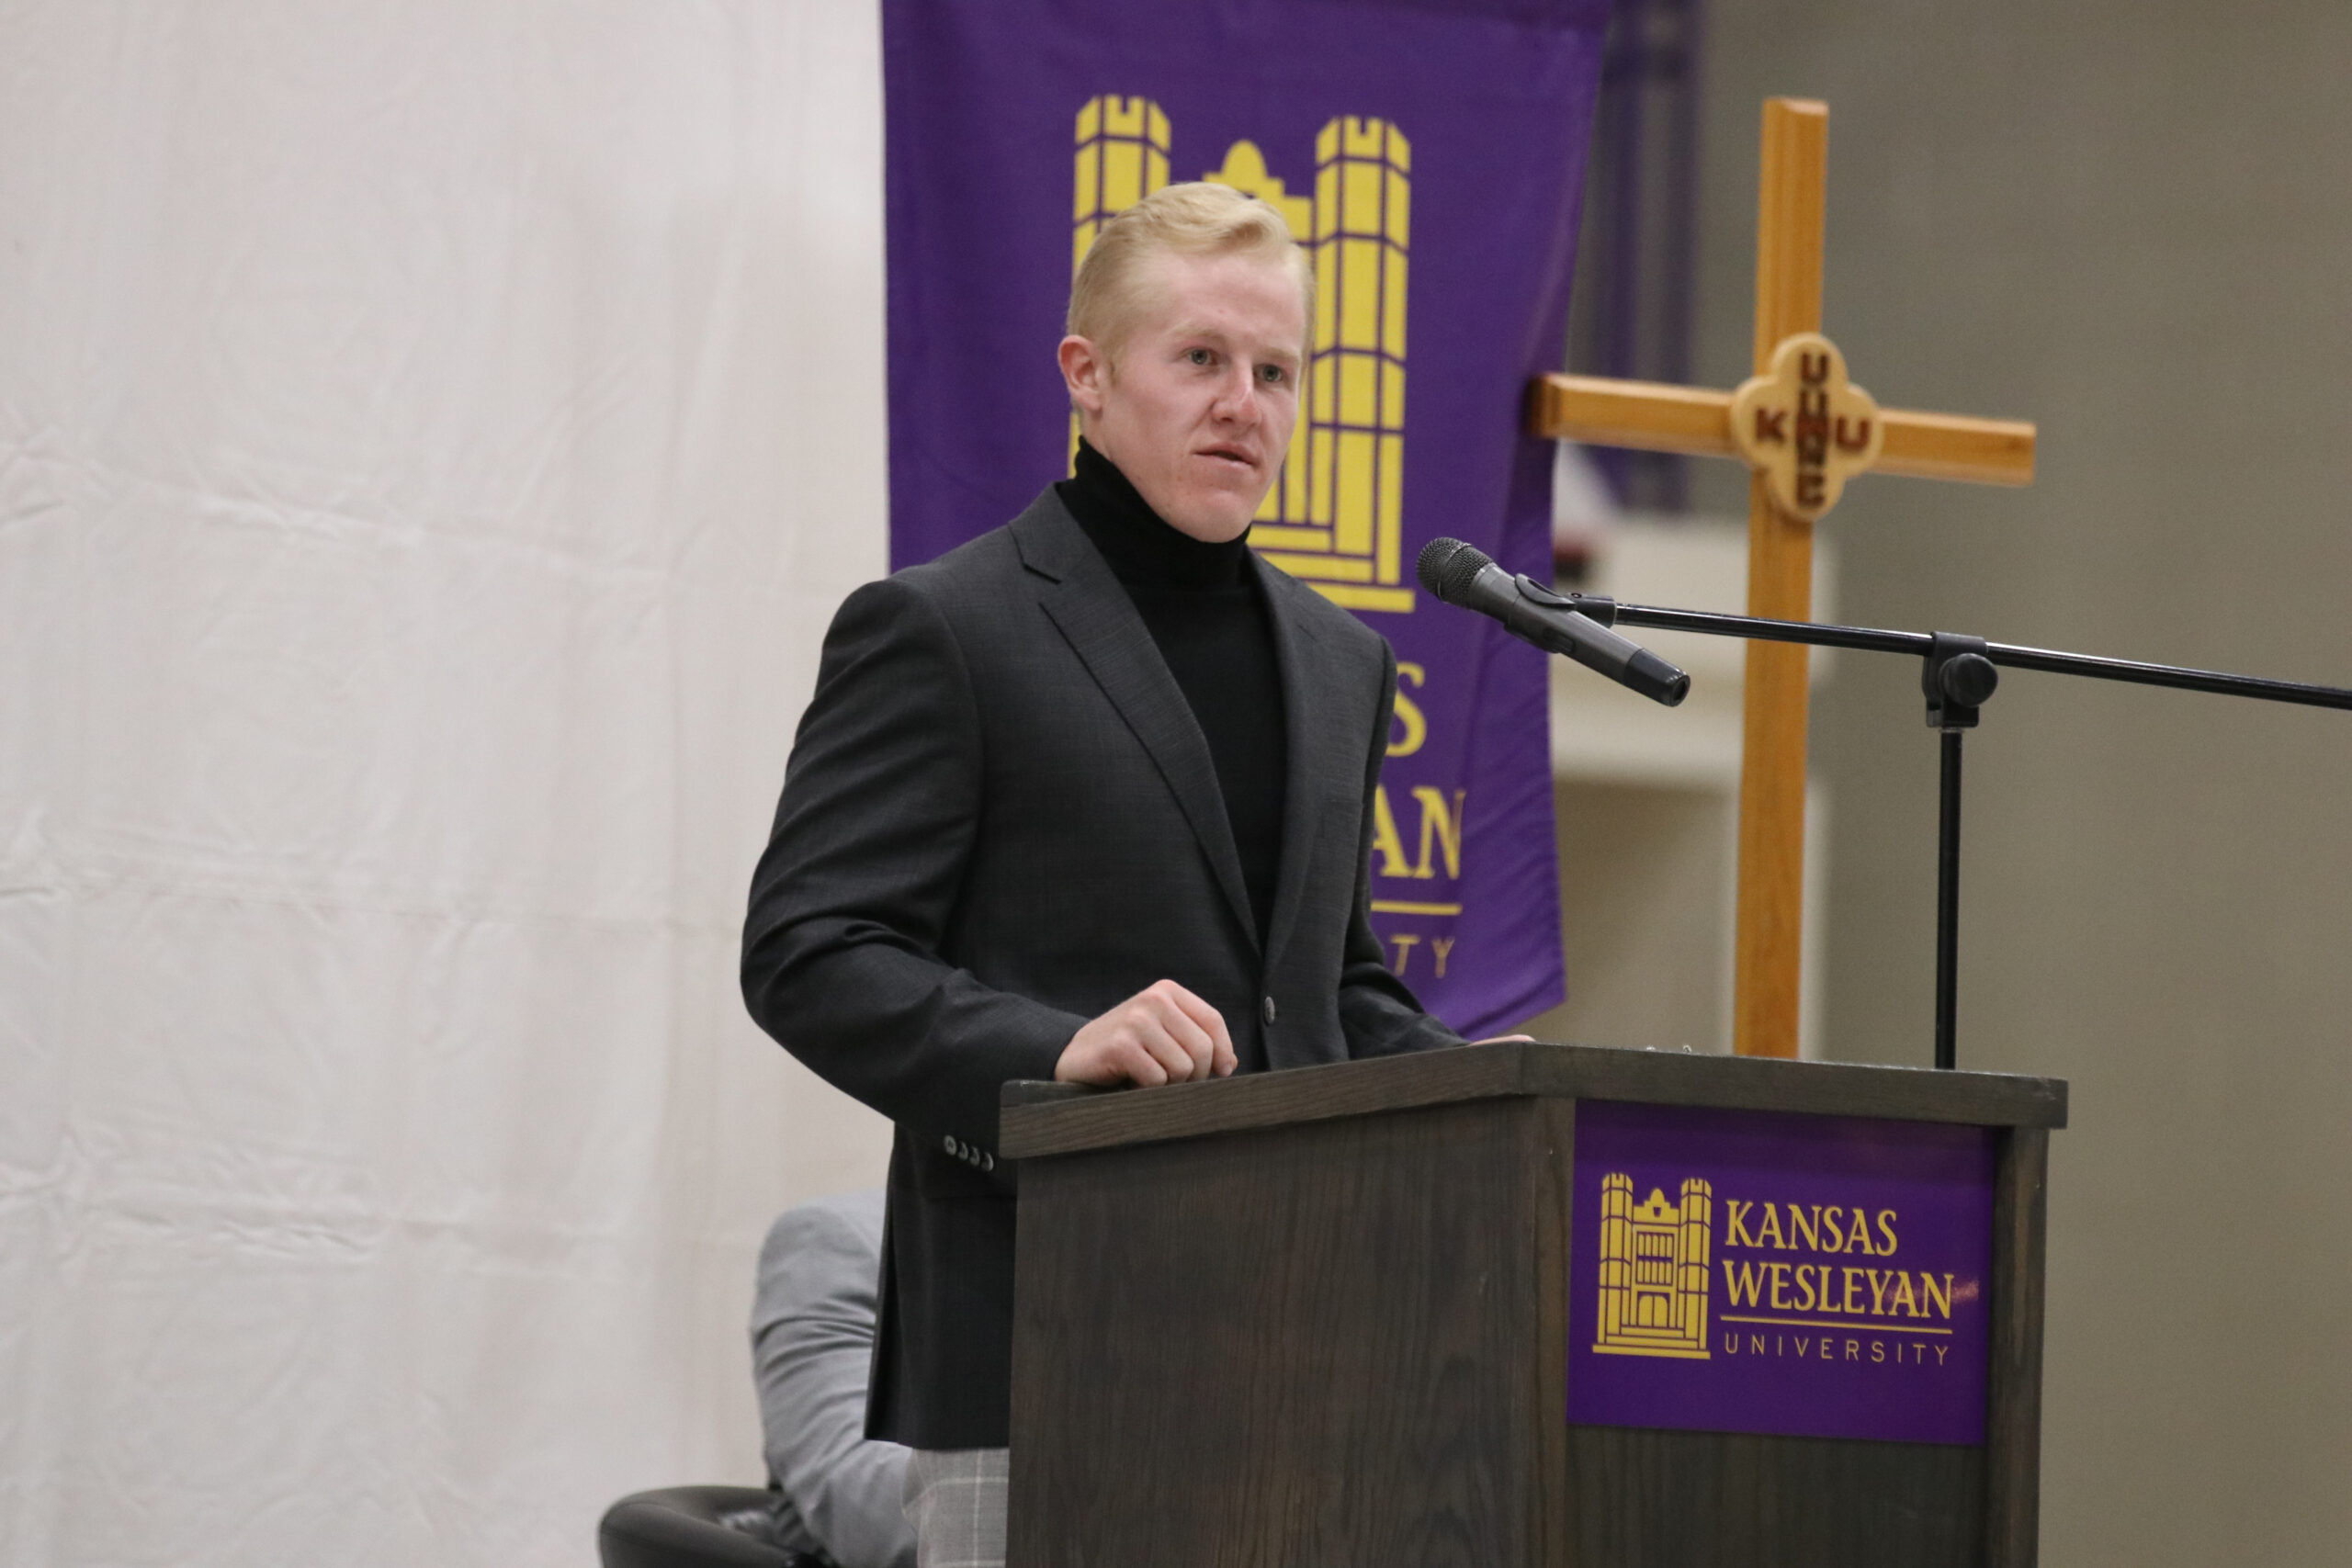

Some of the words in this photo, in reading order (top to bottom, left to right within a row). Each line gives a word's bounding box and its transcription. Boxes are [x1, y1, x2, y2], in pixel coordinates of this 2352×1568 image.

[1724, 1199, 1898, 1257] KANSAS
[1723, 1260, 1954, 1319] WESLEYAN
[1724, 1333, 1949, 1366] UNIVERSITY
